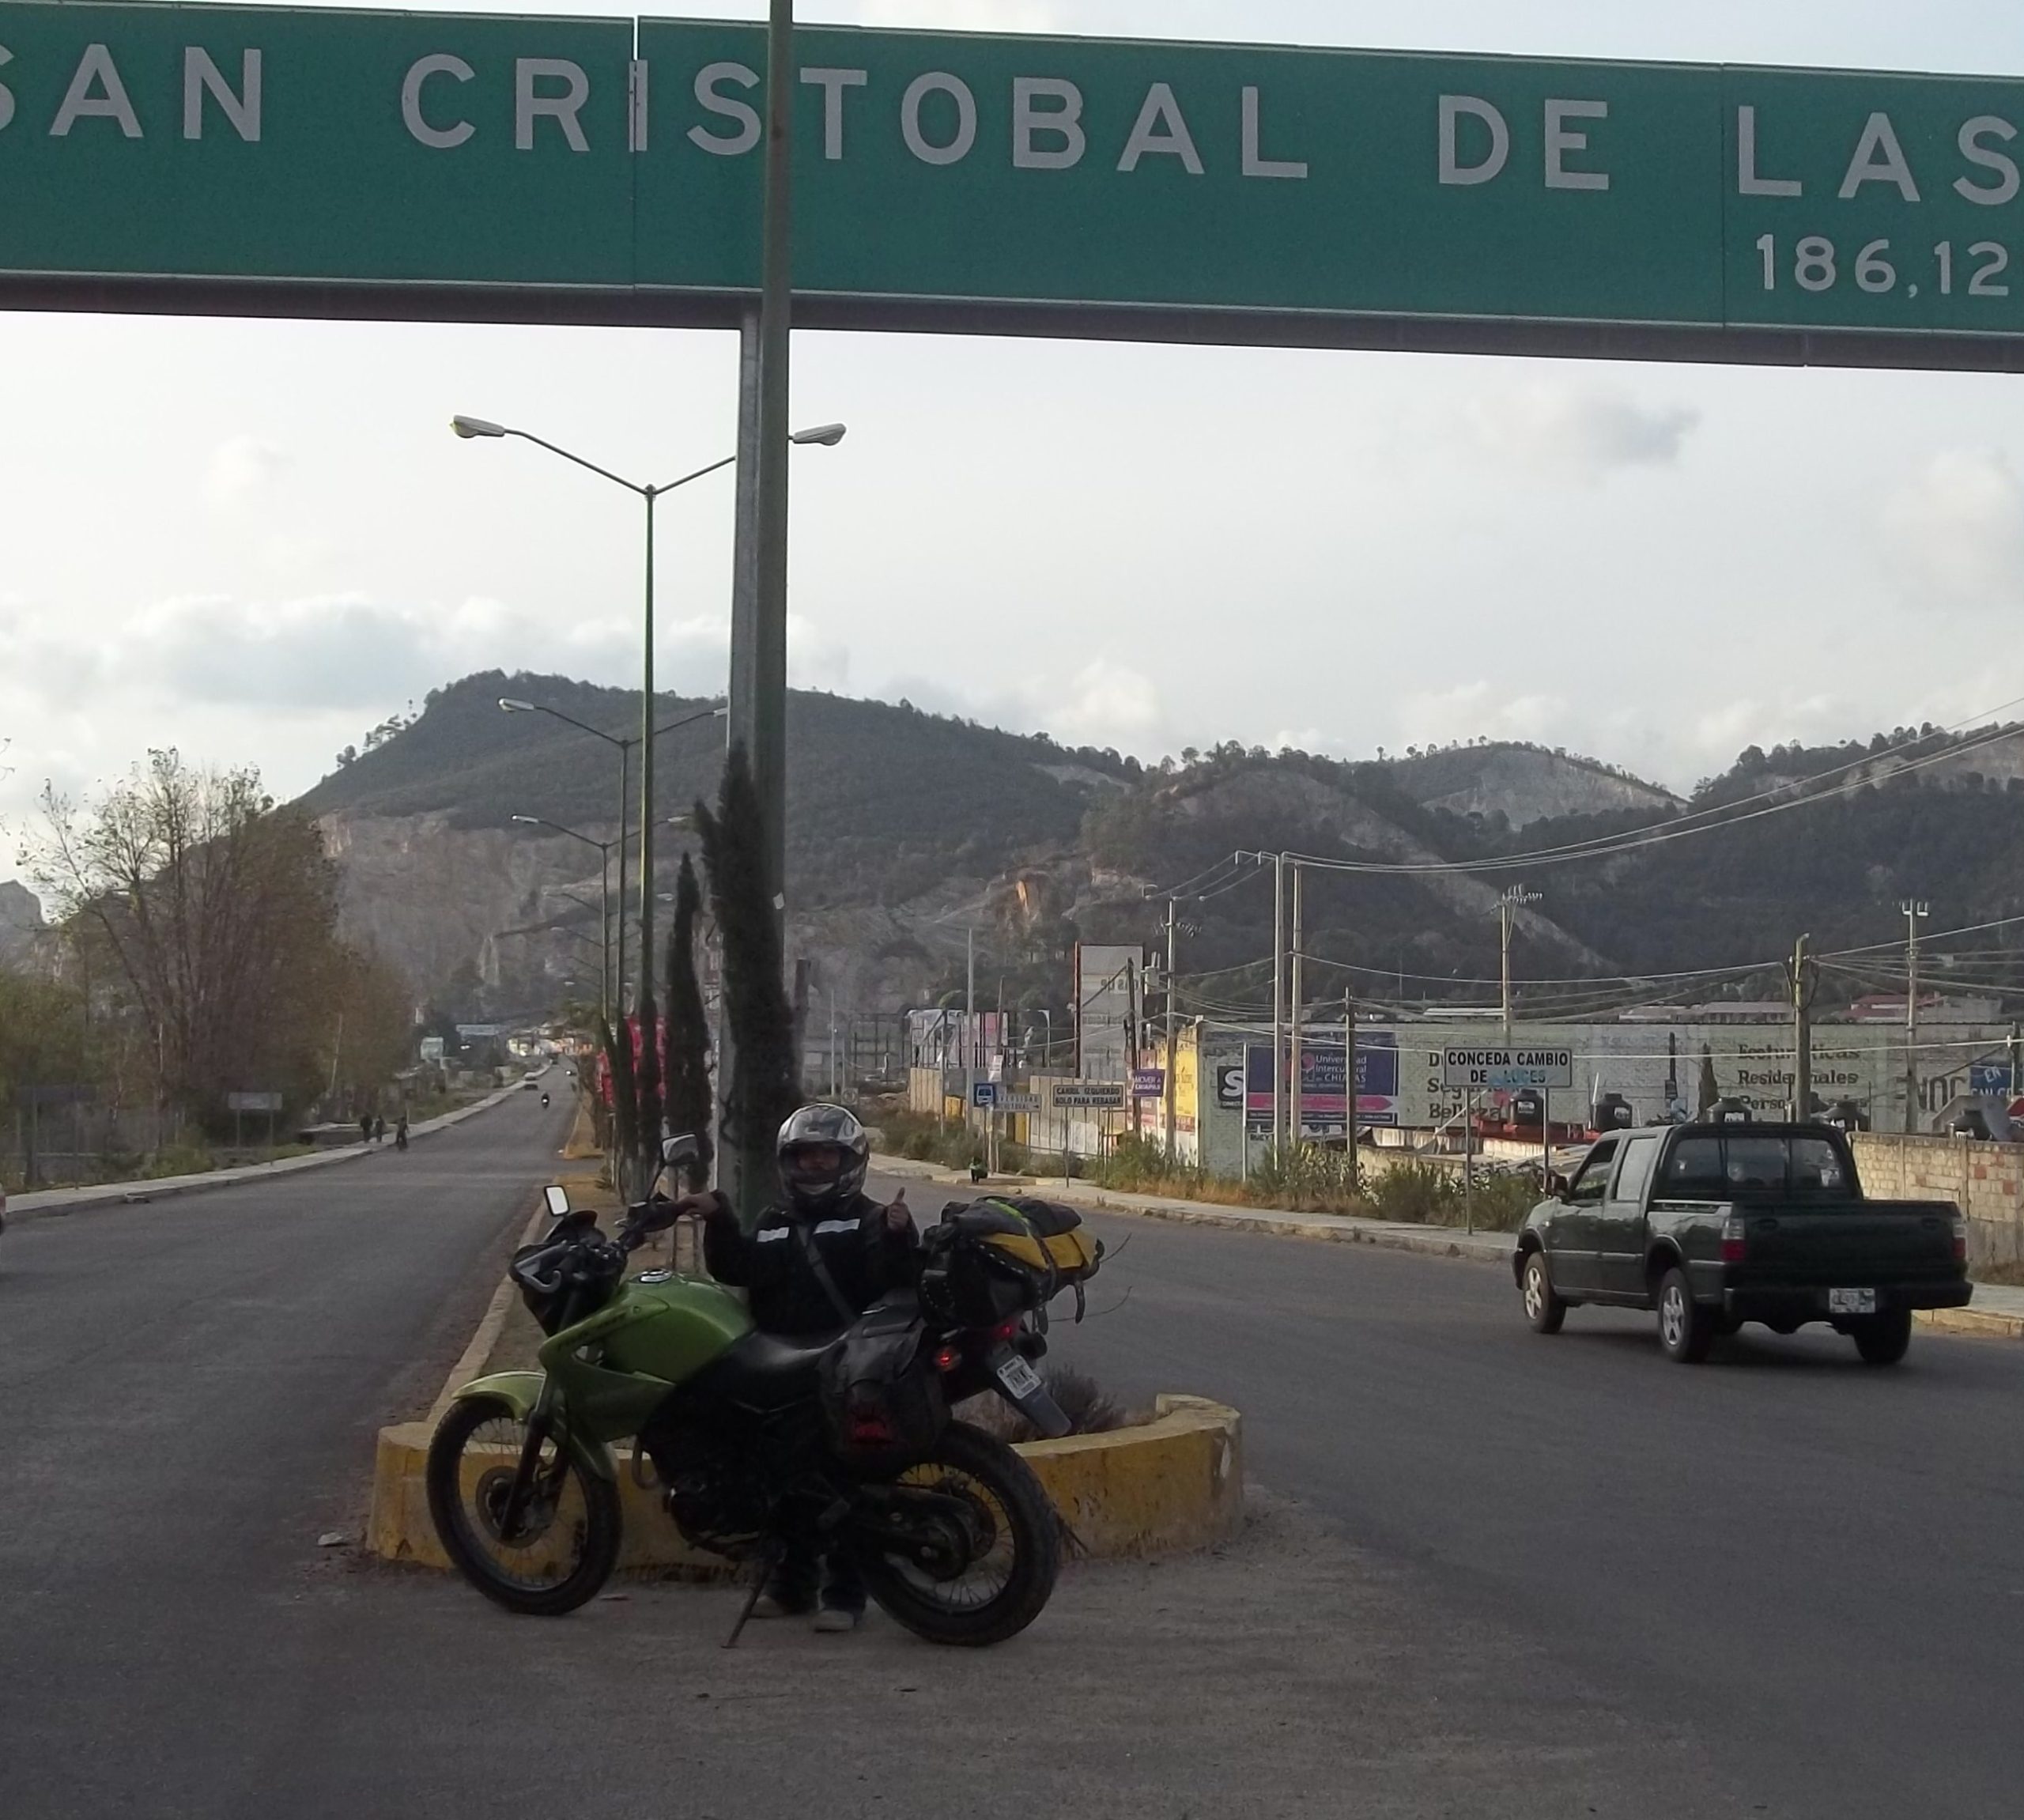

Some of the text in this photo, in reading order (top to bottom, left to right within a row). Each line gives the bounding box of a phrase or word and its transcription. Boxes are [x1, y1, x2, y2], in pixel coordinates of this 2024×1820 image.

[0, 43, 2022, 206] AN CRISTOBAL DE LAS
[1756, 233, 2010, 299] 186,12
[1316, 1055, 1367, 1064] Univerad
[1448, 1052, 1511, 1066] CONCEDA
[1516, 1052, 1568, 1066] CAMBIO
[1471, 1069, 1546, 1083] DE LUCES
